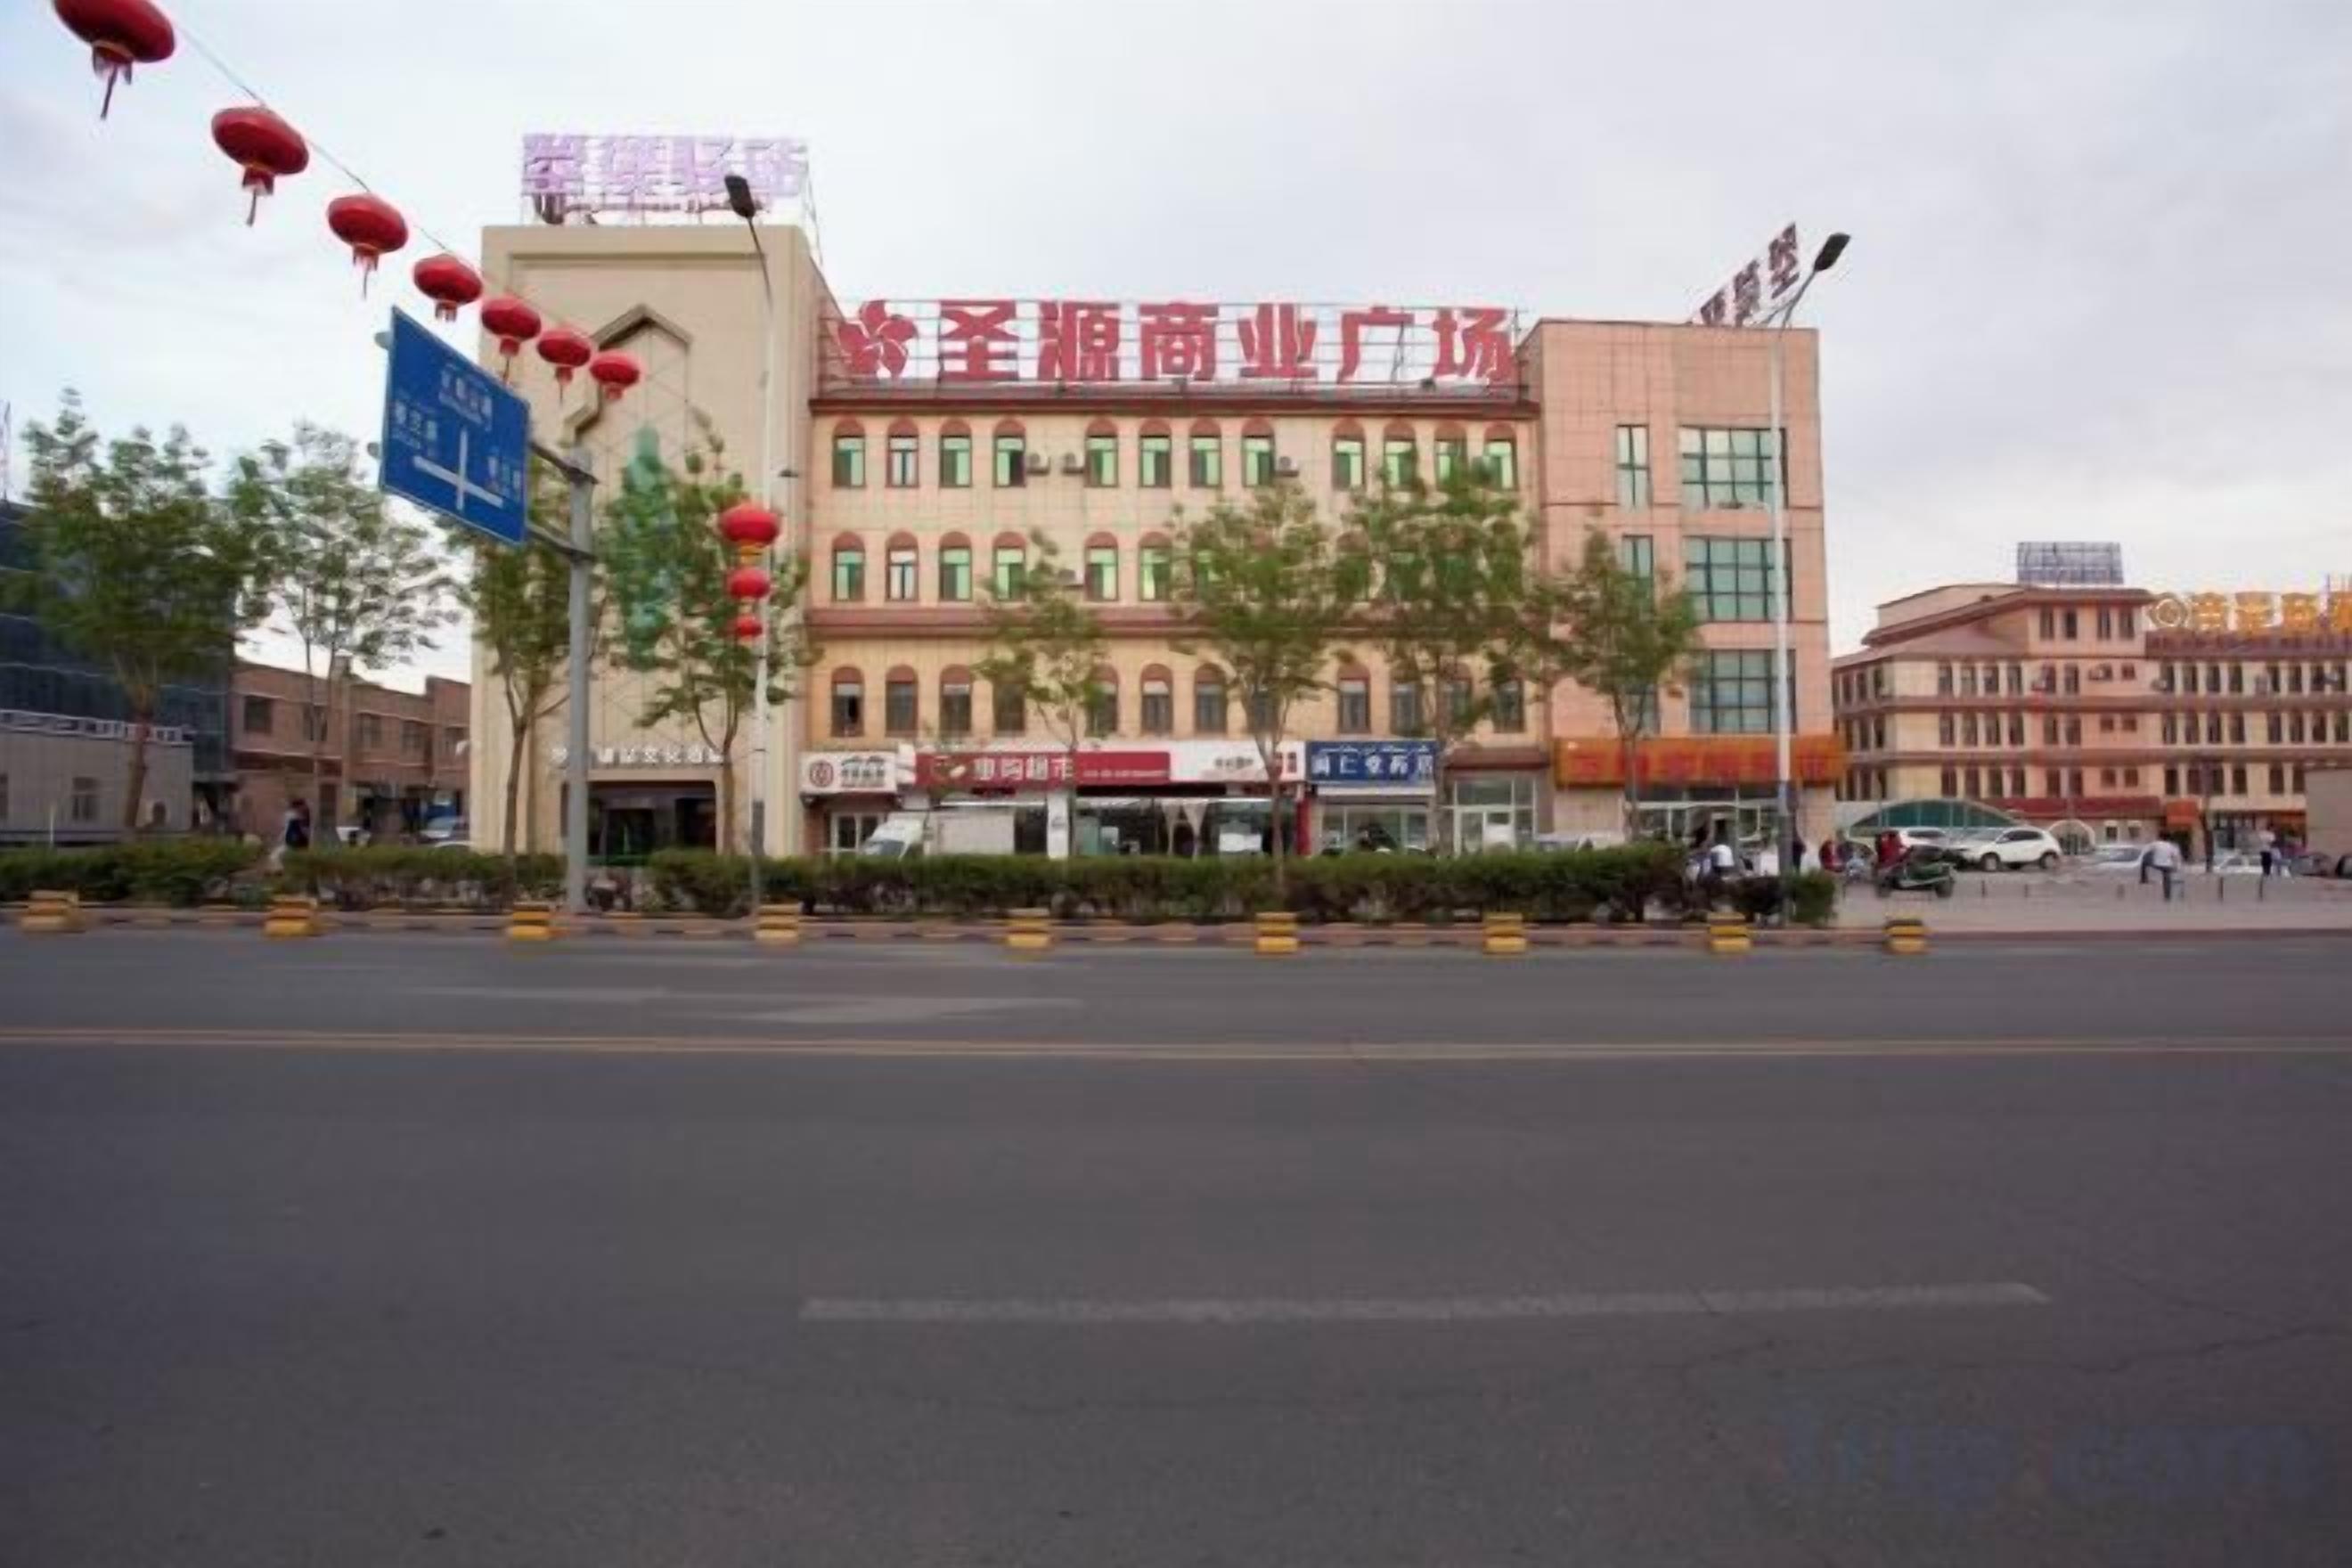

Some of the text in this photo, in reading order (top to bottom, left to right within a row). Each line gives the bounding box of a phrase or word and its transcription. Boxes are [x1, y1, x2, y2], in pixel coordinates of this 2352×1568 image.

[939, 300, 1513, 391] 圣源商业广场
